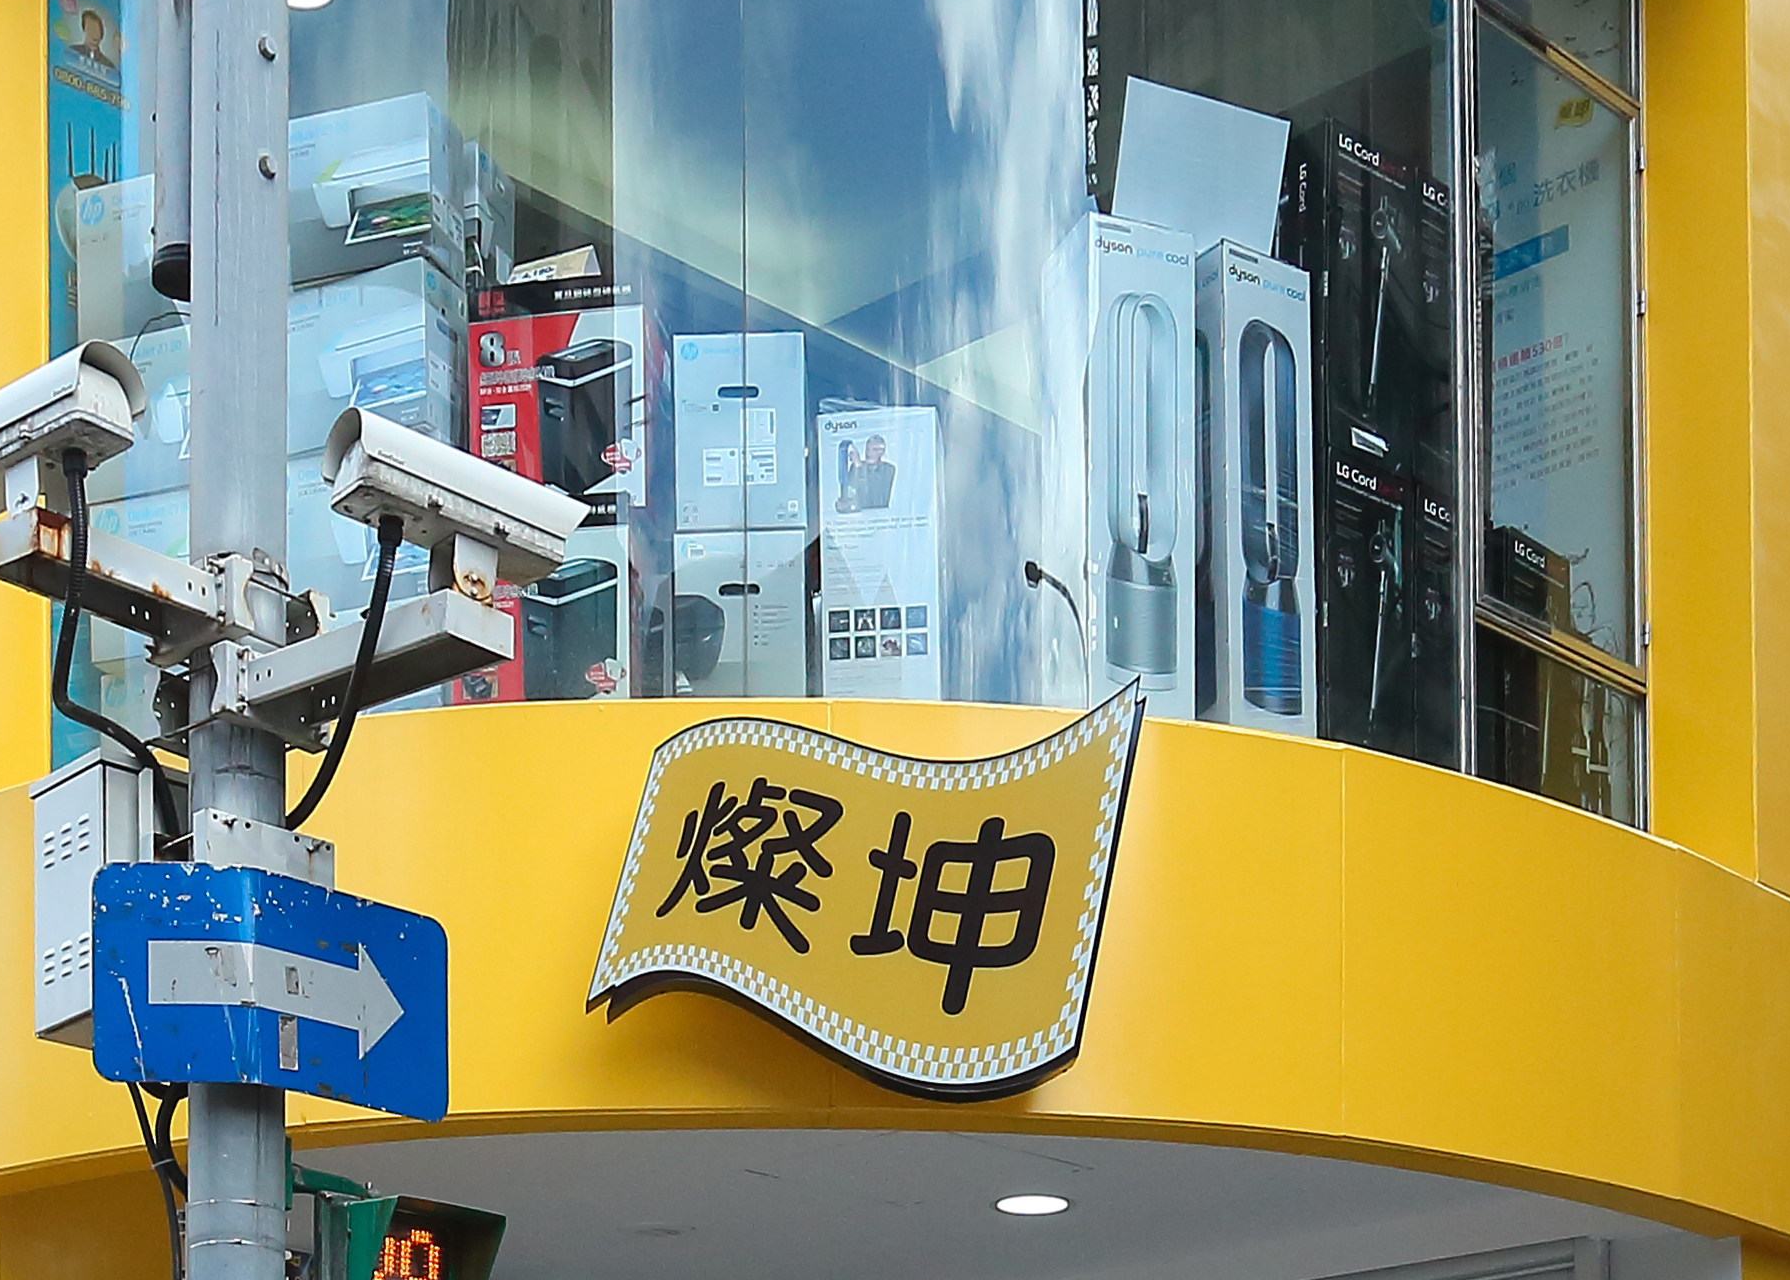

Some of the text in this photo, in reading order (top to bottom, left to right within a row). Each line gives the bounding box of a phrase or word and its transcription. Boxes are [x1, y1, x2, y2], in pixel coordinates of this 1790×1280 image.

[1338, 132, 1354, 151] LG
[80, 193, 106, 224] hp
[1094, 234, 1134, 256] dyson
[1165, 251, 1190, 267] cool
[1228, 263, 1261, 285] dyson
[1286, 284, 1307, 302] cool
[680, 342, 700, 362] hp
[823, 419, 858, 434] dyson
[1336, 462, 1350, 480] LG
[1513, 540, 1526, 557] LG
[656, 777, 1056, 1015] 燦坤
